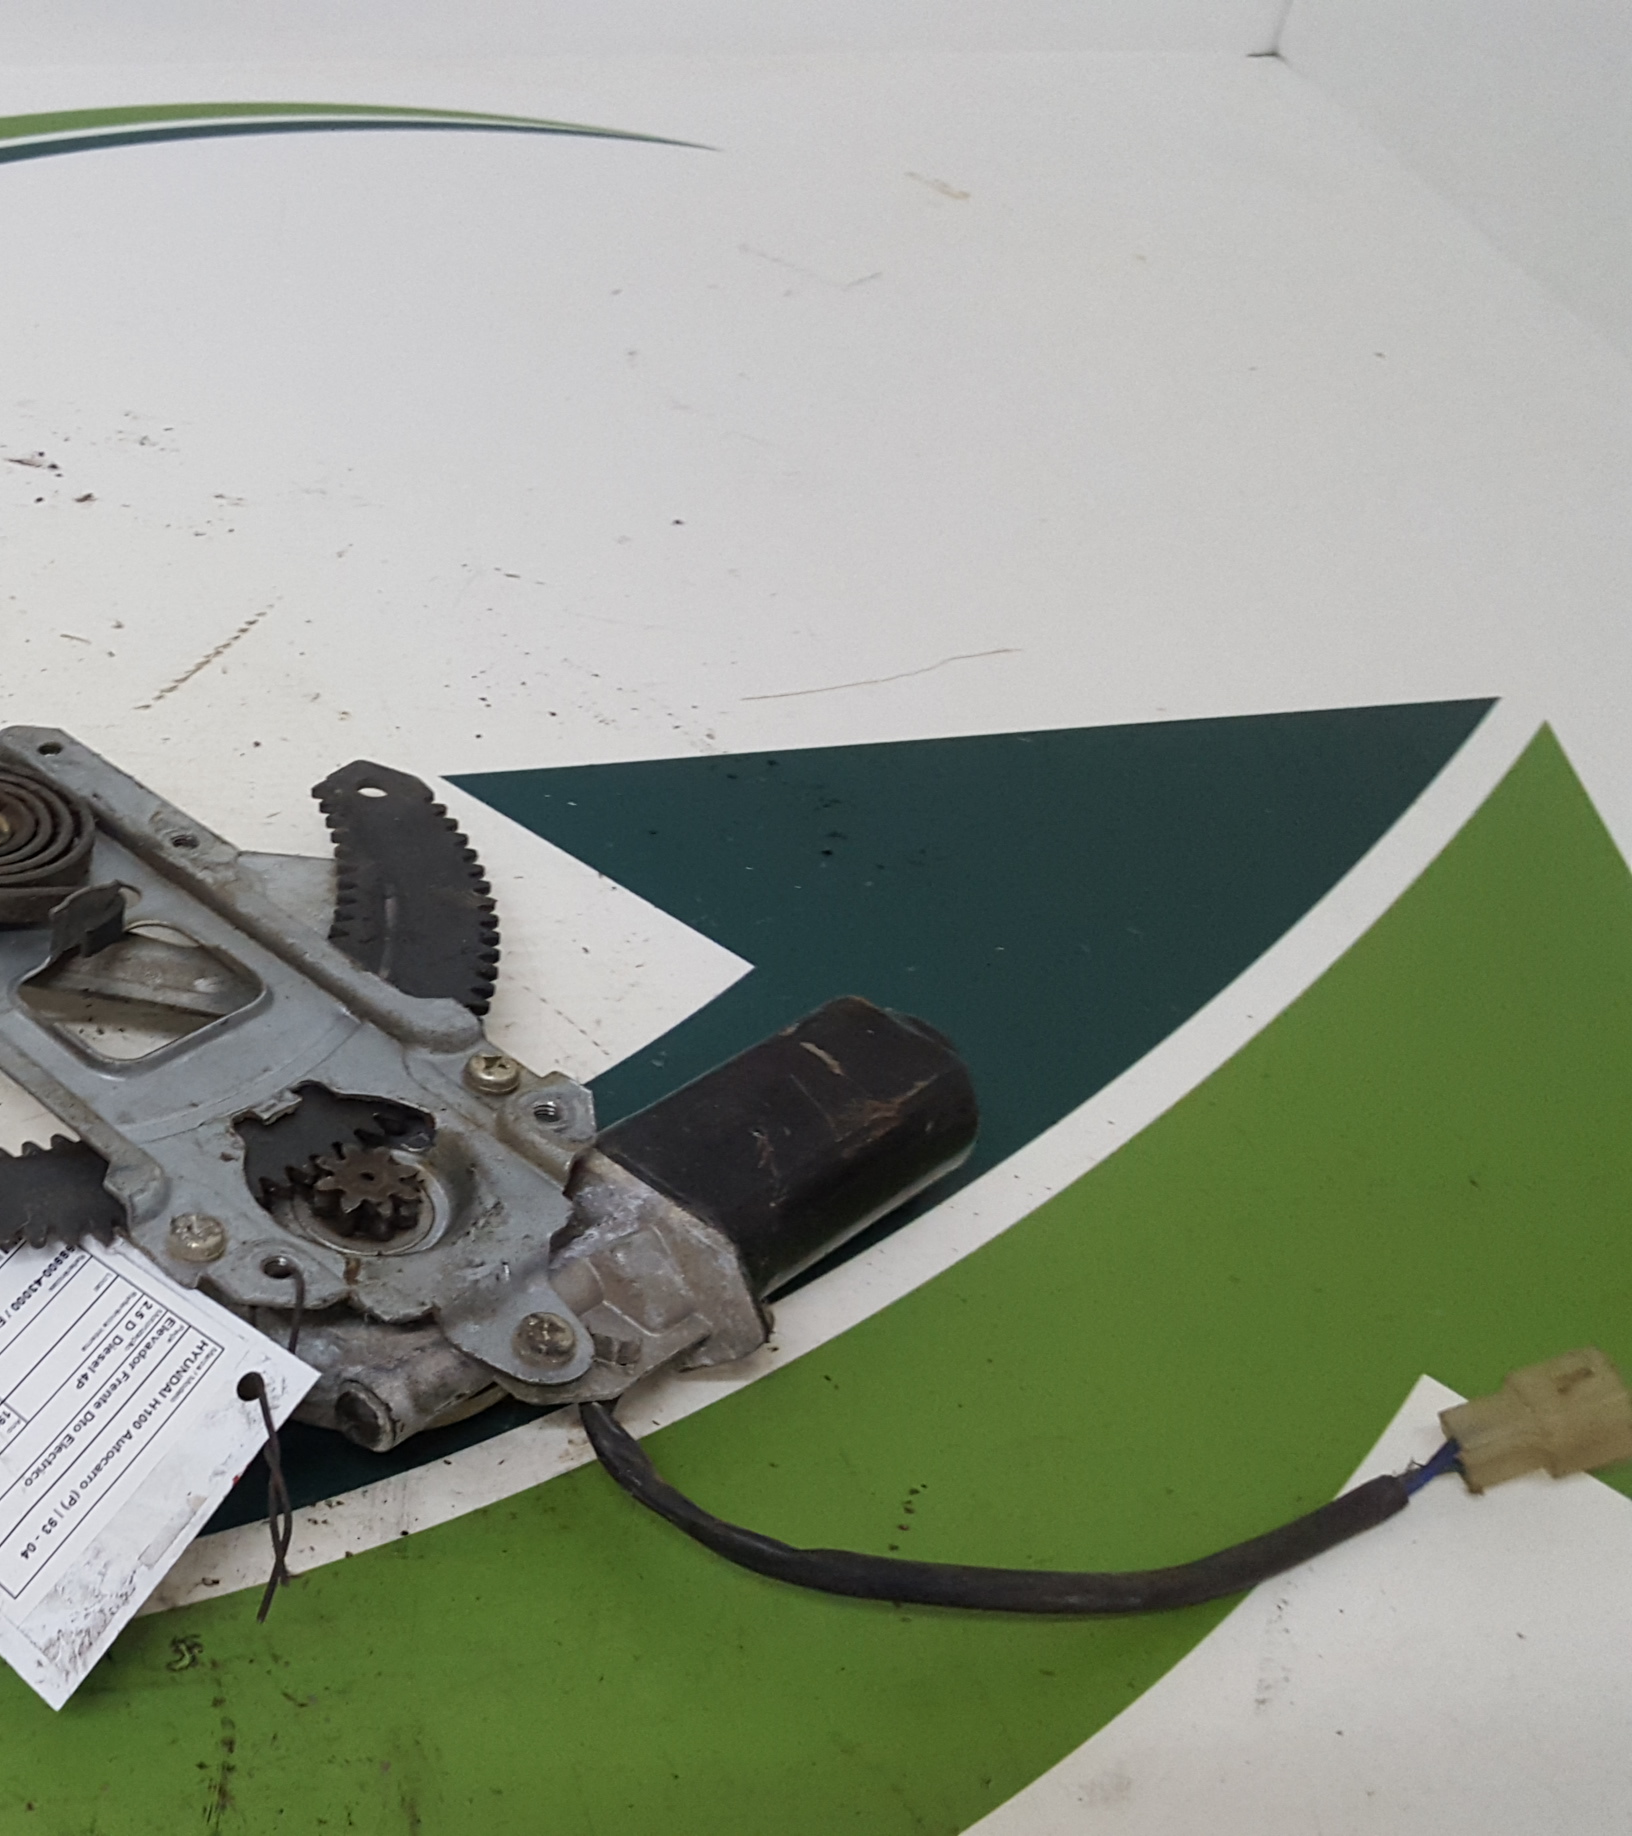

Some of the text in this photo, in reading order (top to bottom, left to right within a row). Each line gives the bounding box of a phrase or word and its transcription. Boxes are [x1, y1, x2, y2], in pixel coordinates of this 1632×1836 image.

[76, 1300, 153, 1390] 2.5 D Diesel 4P
[158, 1339, 209, 1399] HYUNDAI
[24, 1316, 177, 1487] Elevador Frente Dto Electrico
[132, 1397, 162, 1430] H100
[79, 1429, 133, 1490] Autocarro
[60, 1490, 81, 1511] (P)
[41, 1517, 58, 1535] 93
[20, 1542, 37, 1560] 04
